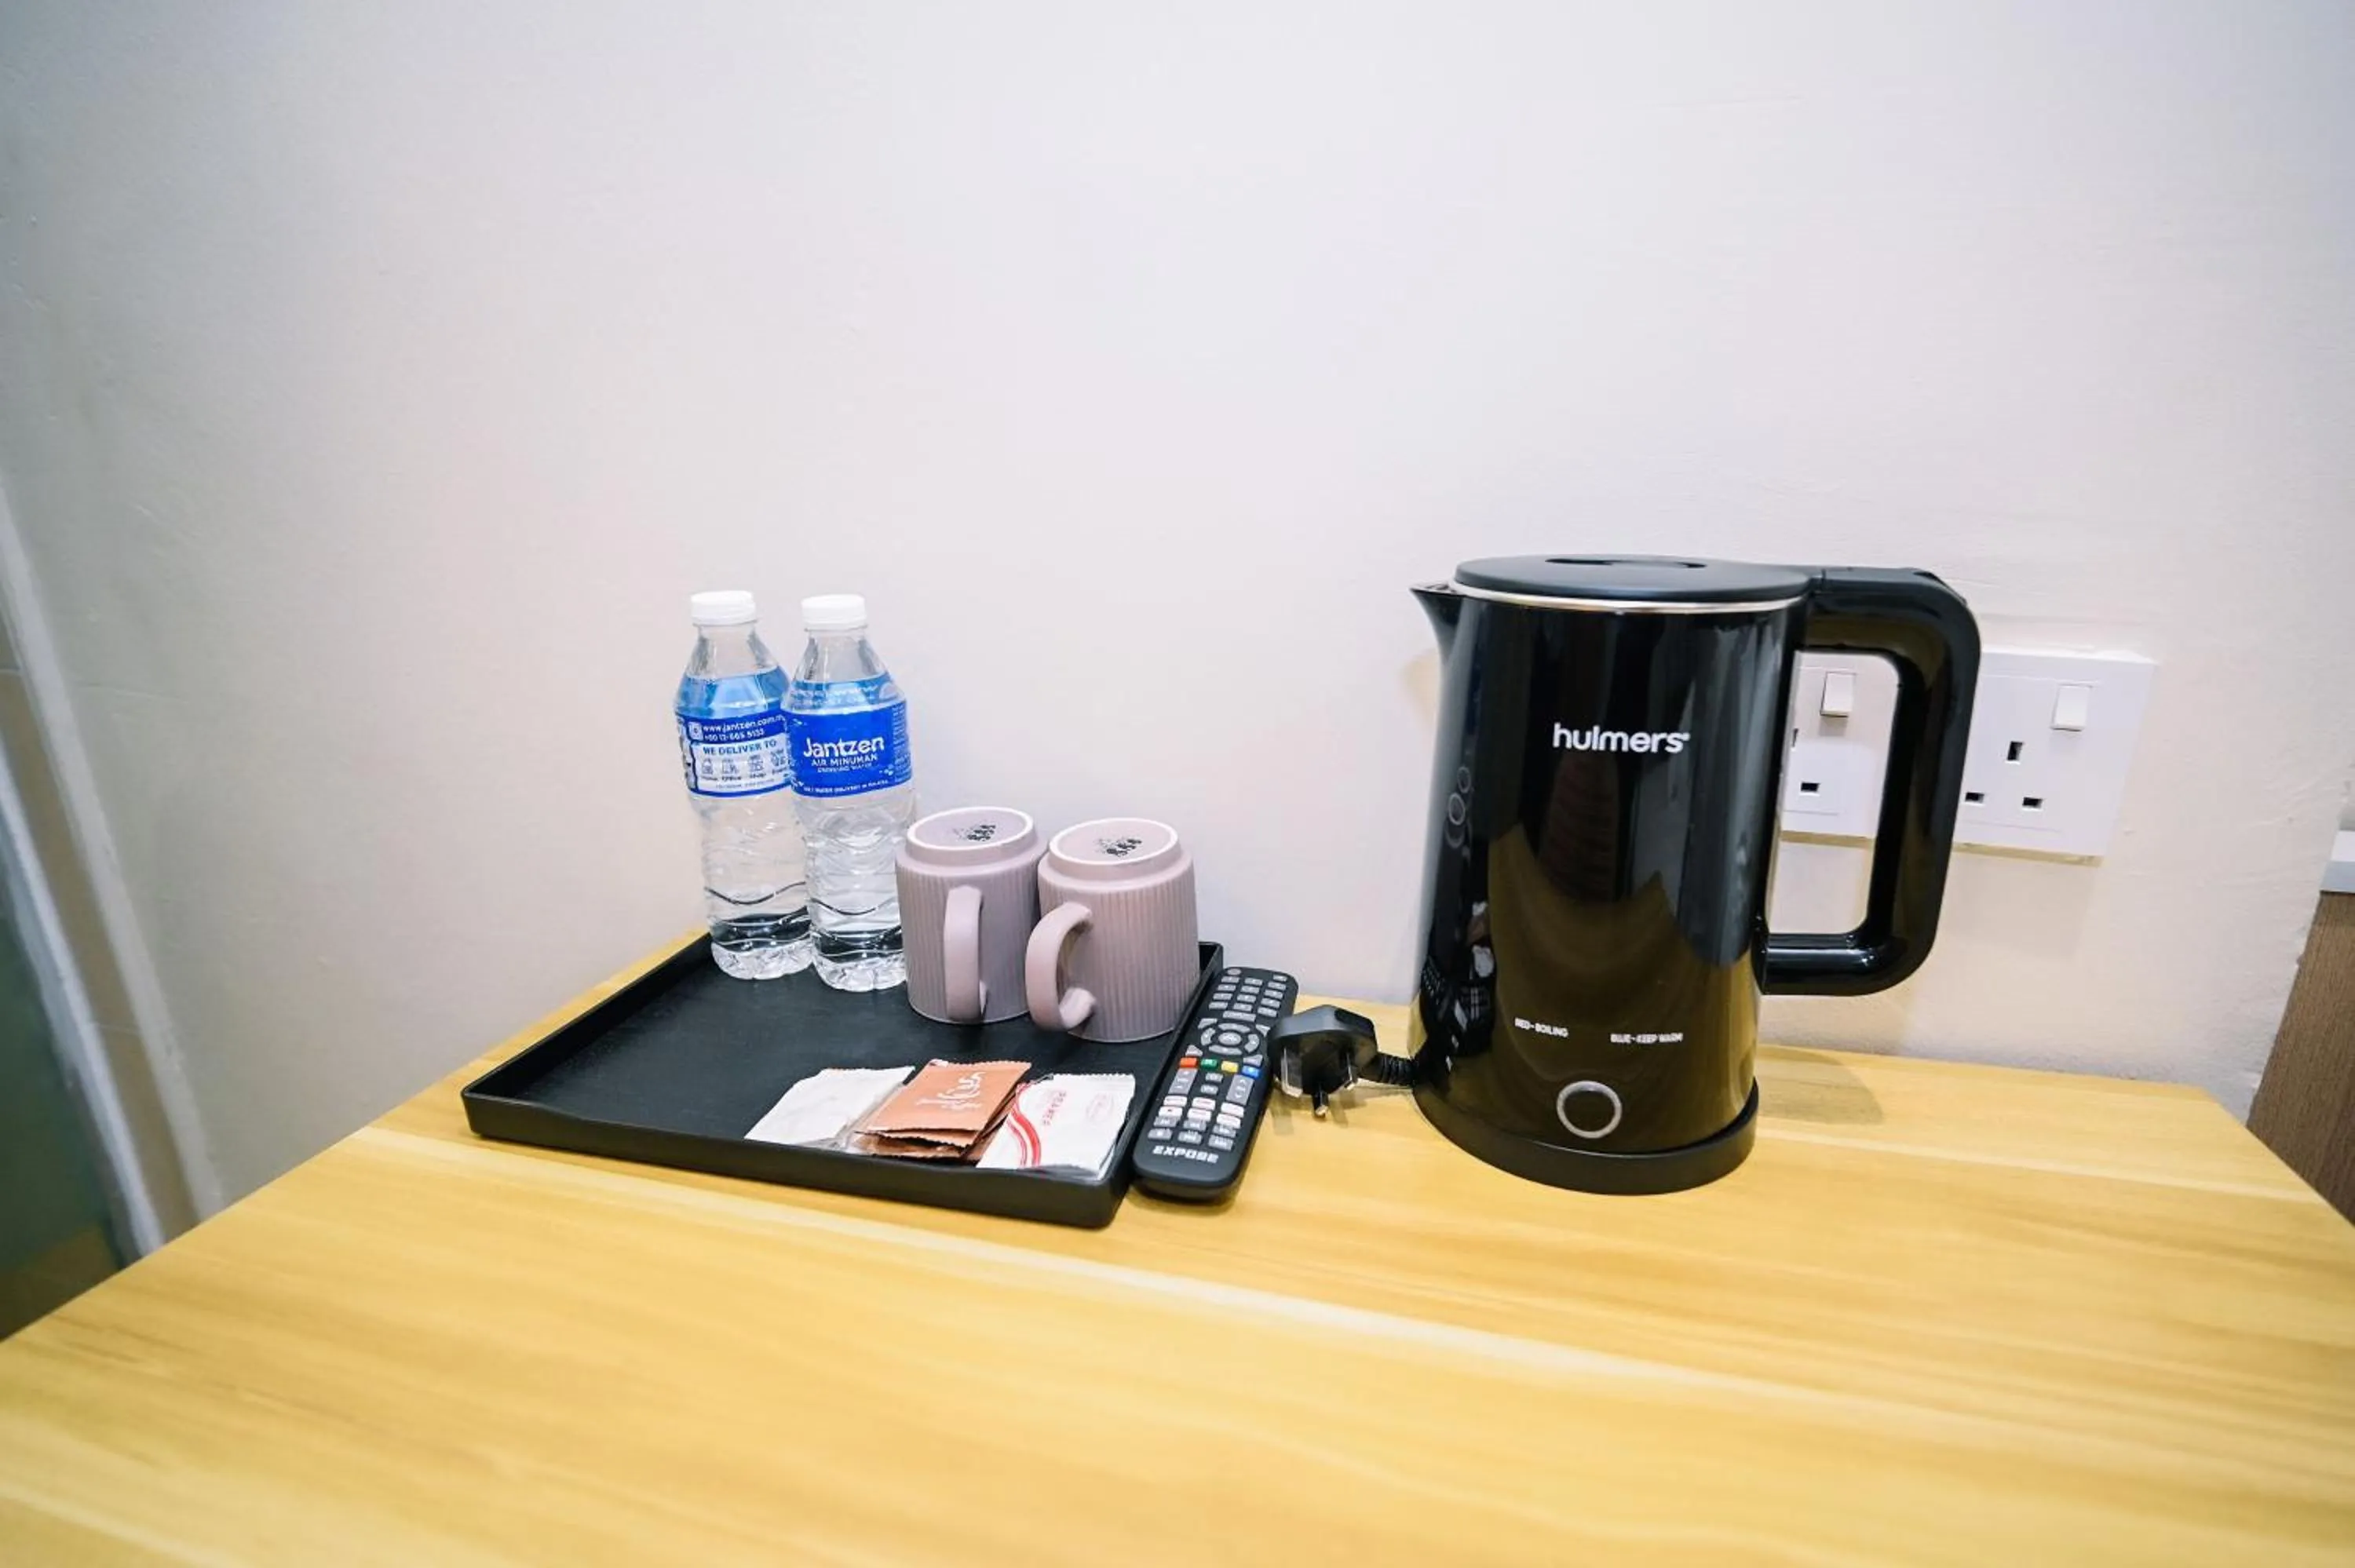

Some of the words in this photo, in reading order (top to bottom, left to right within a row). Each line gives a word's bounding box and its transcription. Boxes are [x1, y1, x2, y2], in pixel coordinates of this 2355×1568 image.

[718, 743, 762, 754] DELIVER
[764, 738, 777, 749] TO
[803, 736, 885, 758] Jantzen
[1553, 722, 1685, 753] hulmers
[811, 758, 827, 767] AIR
[830, 753, 878, 767] MINUMAN
[1152, 1144, 1219, 1164] EXPOSE
